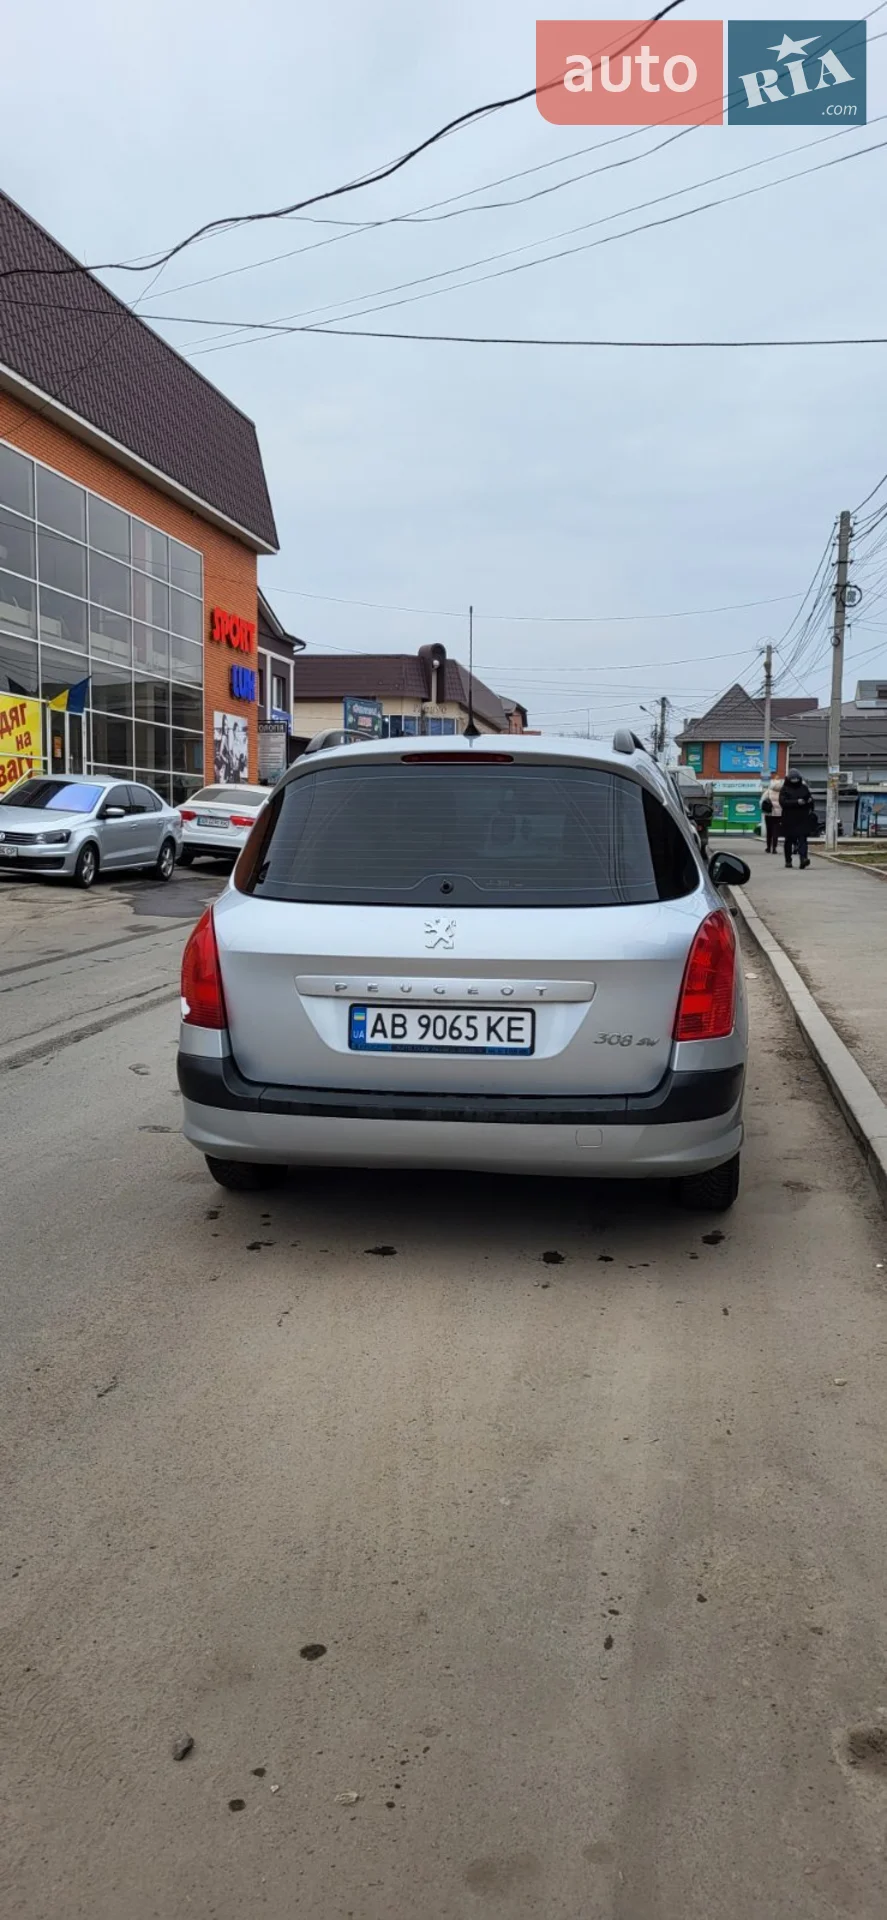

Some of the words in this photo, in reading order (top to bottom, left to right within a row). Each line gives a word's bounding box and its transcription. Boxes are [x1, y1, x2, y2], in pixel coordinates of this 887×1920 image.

[212, 606, 256, 656] SPORT
[15, 731, 32, 751] на
[334, 982, 548, 996] PEUGEOT
[353, 1030, 365, 1039] UA
[370, 1013, 408, 1039] AB
[417, 1014, 479, 1041] 9065
[486, 1016, 525, 1043] KE
[593, 1031, 633, 1047] 308
